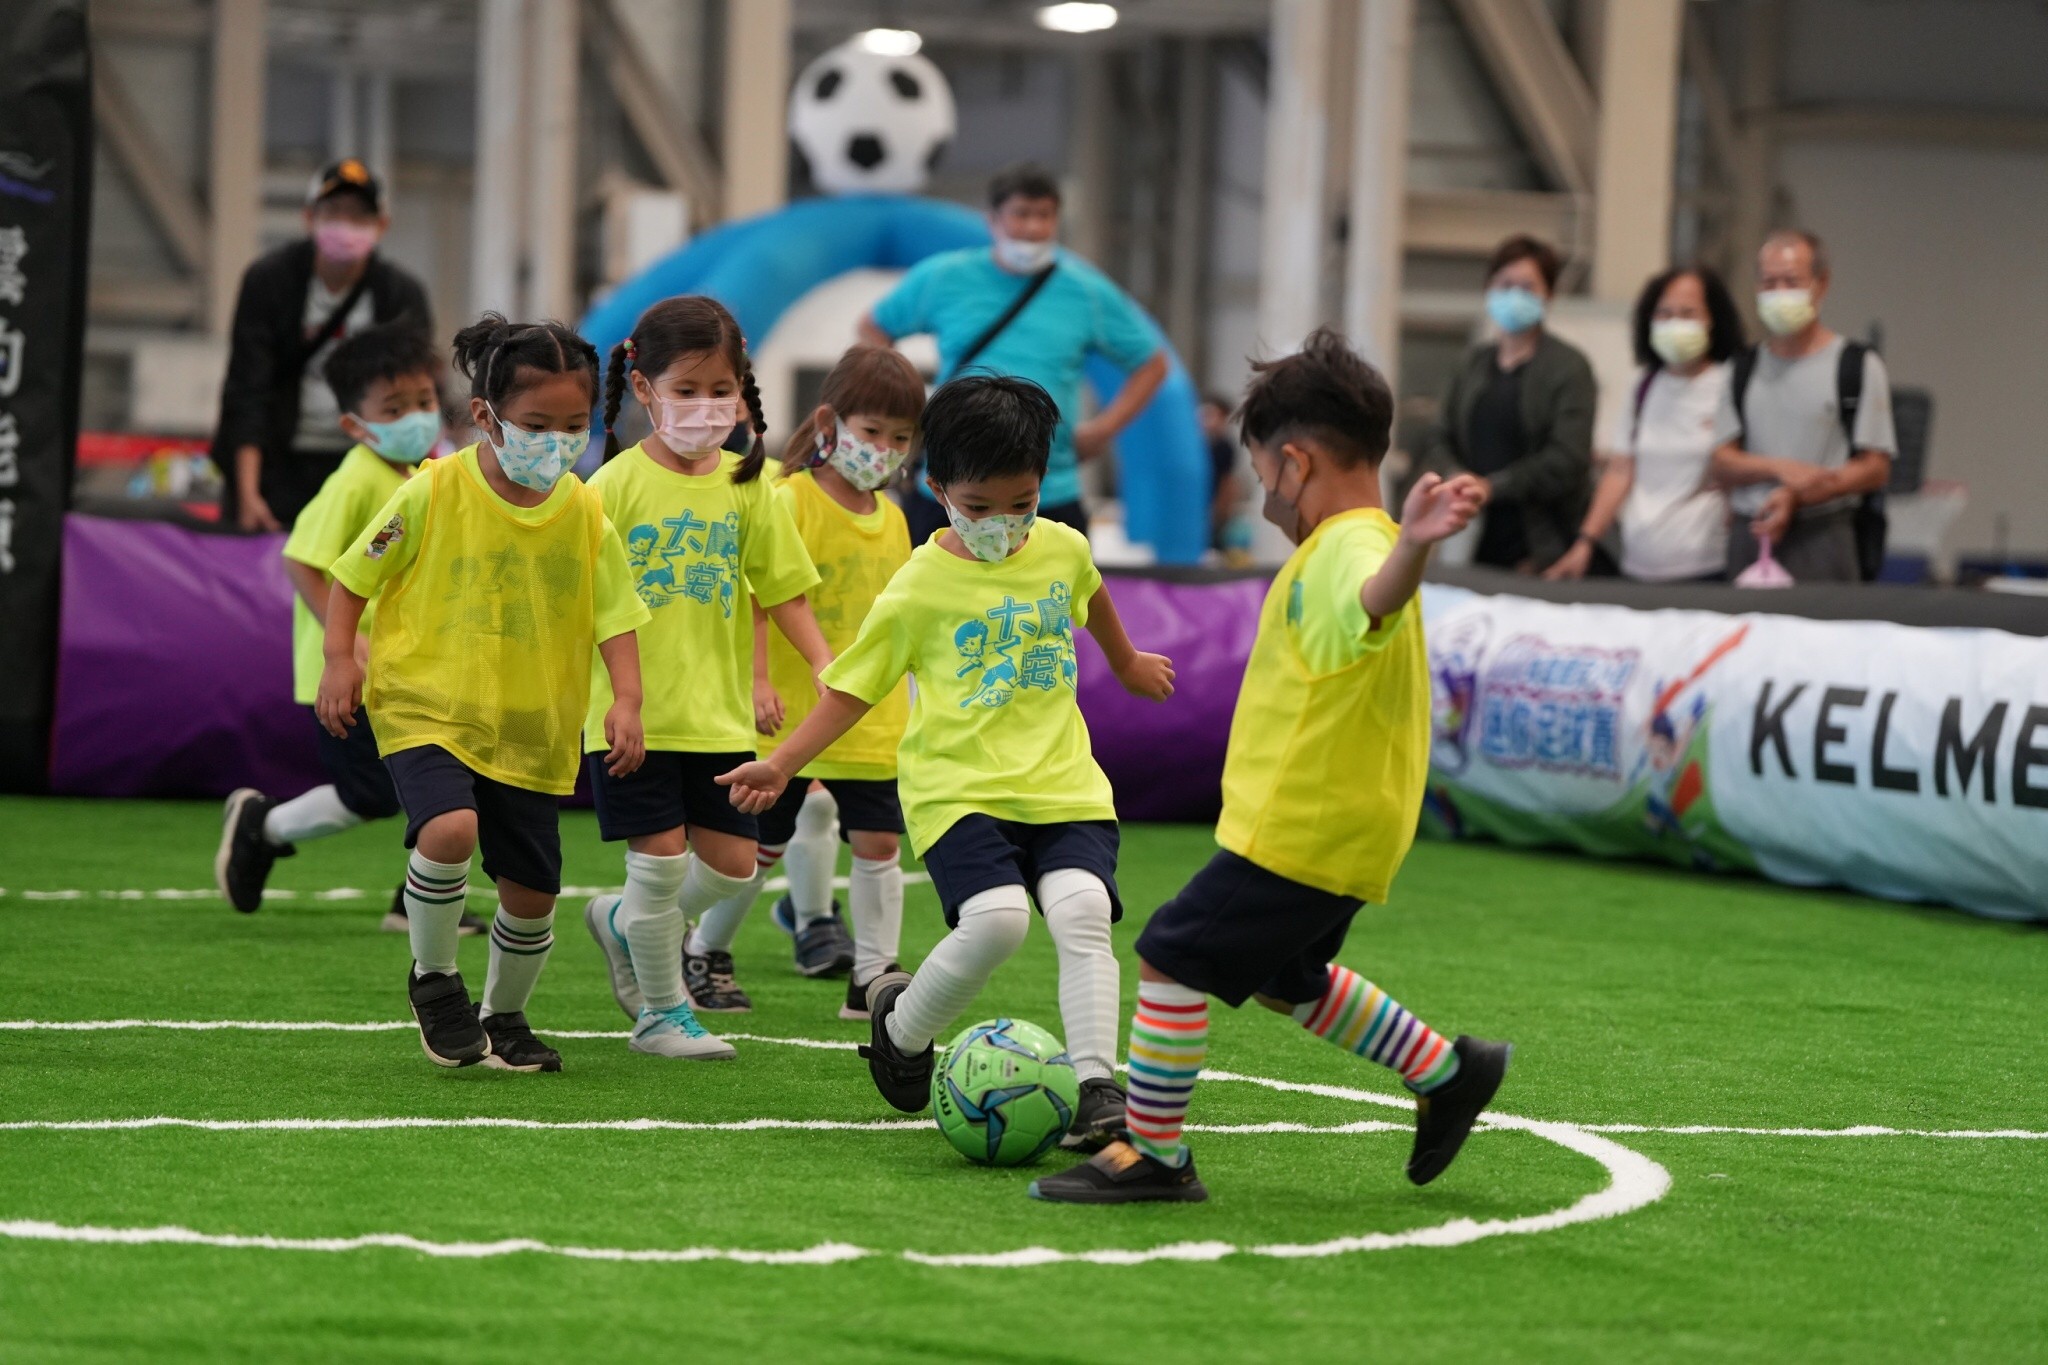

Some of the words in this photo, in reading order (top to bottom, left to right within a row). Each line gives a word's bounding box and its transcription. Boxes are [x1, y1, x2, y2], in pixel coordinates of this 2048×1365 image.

[662, 508, 723, 604] 大安
[987, 595, 1057, 691] 大安
[1748, 678, 2048, 809] KELME
